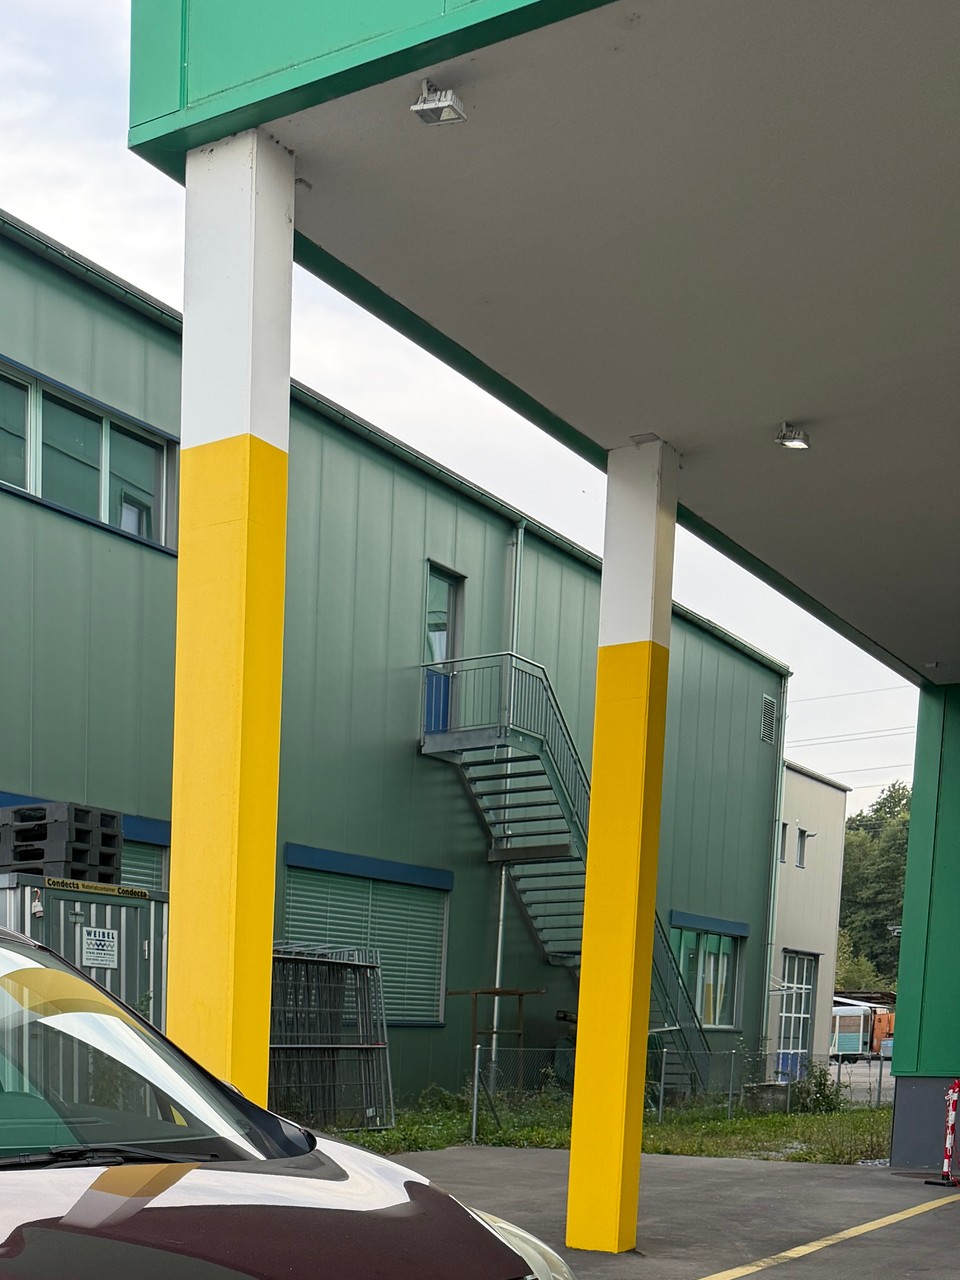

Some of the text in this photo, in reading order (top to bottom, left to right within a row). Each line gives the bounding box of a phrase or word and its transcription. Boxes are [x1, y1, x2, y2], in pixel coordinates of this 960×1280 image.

[47, 878, 80, 890] Condecta
[117, 887, 147, 898] Condecta
[86, 929, 115, 940] WEIBEL
